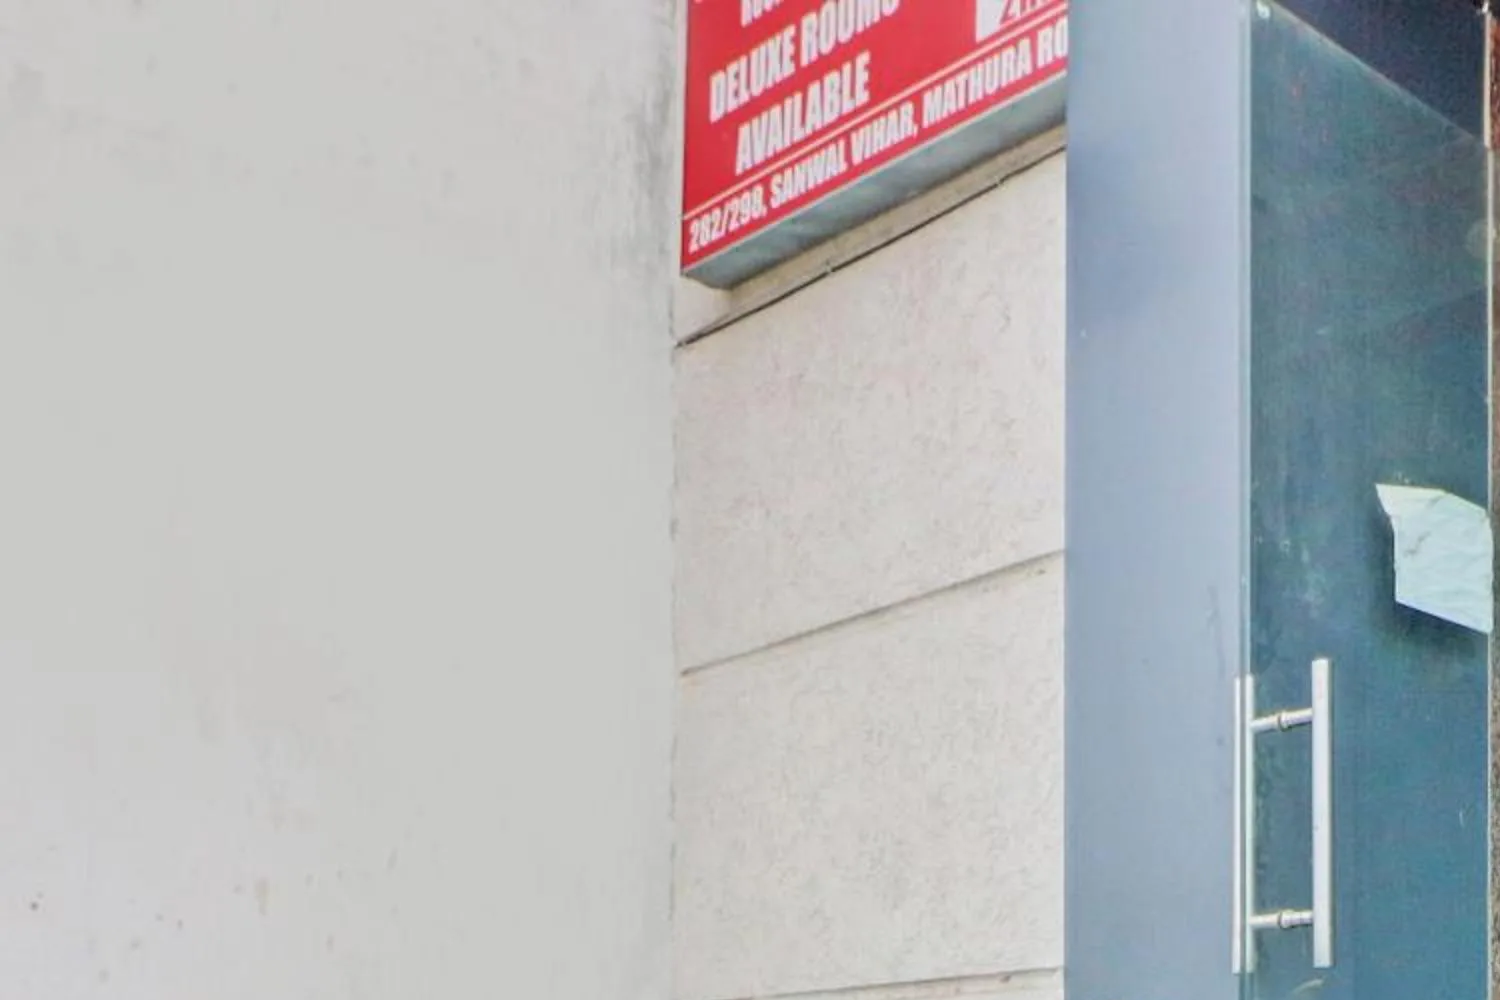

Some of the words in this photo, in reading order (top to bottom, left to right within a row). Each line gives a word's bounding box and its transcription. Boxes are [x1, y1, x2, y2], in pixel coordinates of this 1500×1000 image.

[709, 24, 796, 124] DELUXE
[735, 50, 870, 176] AVAILABLE
[769, 138, 848, 209] SANWAL
[851, 100, 918, 167] VIHAR,
[921, 36, 1032, 130] MATHURA
